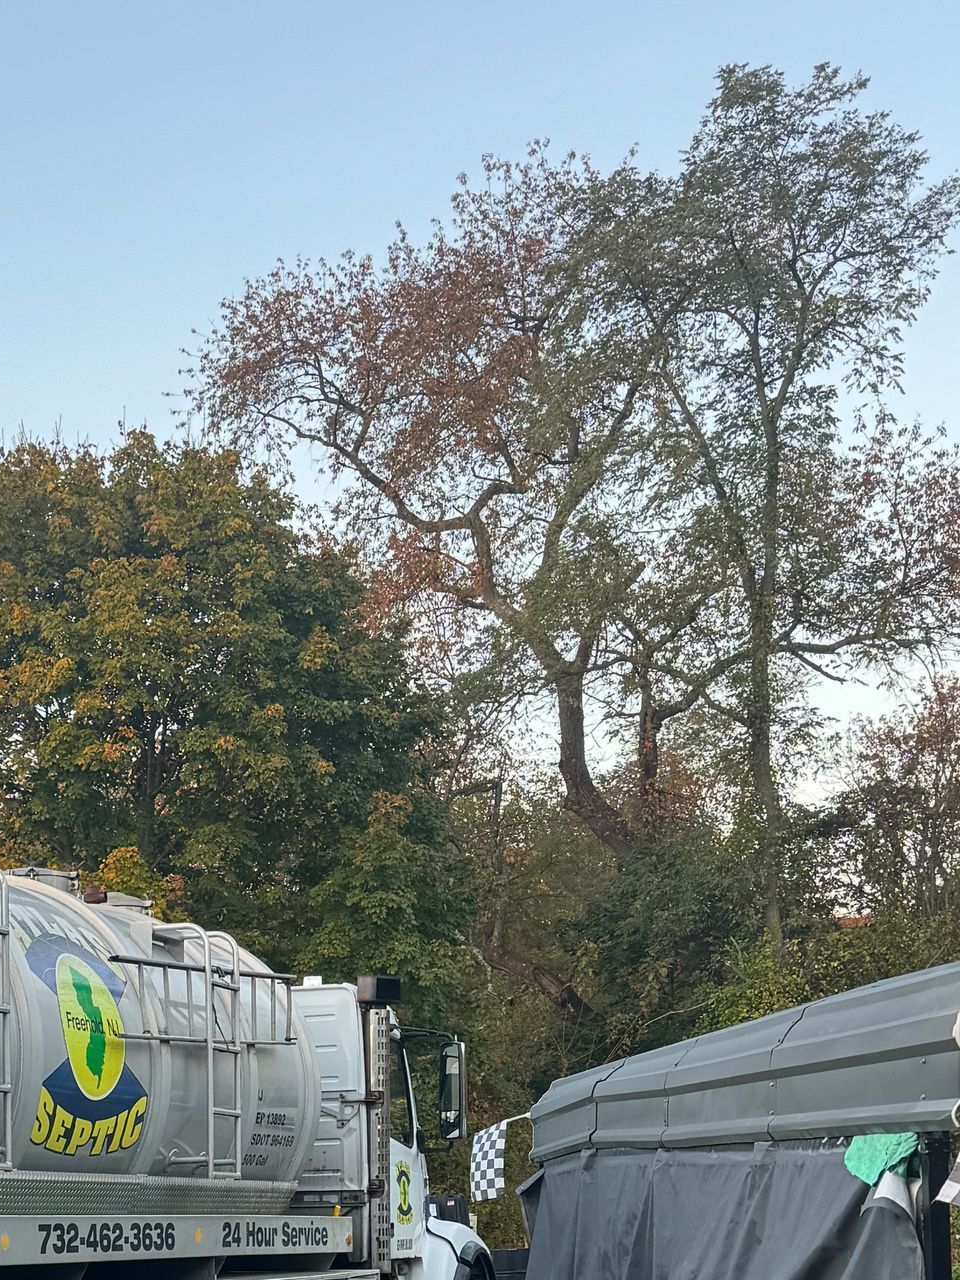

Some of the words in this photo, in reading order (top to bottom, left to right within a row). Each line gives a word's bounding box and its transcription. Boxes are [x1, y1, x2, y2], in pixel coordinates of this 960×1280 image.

[30, 1086, 148, 1157] SEPTIC
[255, 1155, 269, 1166] Gal
[38, 1222, 176, 1254] 732-462-3636
[222, 1221, 241, 1248] 24
[246, 1221, 278, 1248] Hour
[282, 1220, 328, 1247] Service
